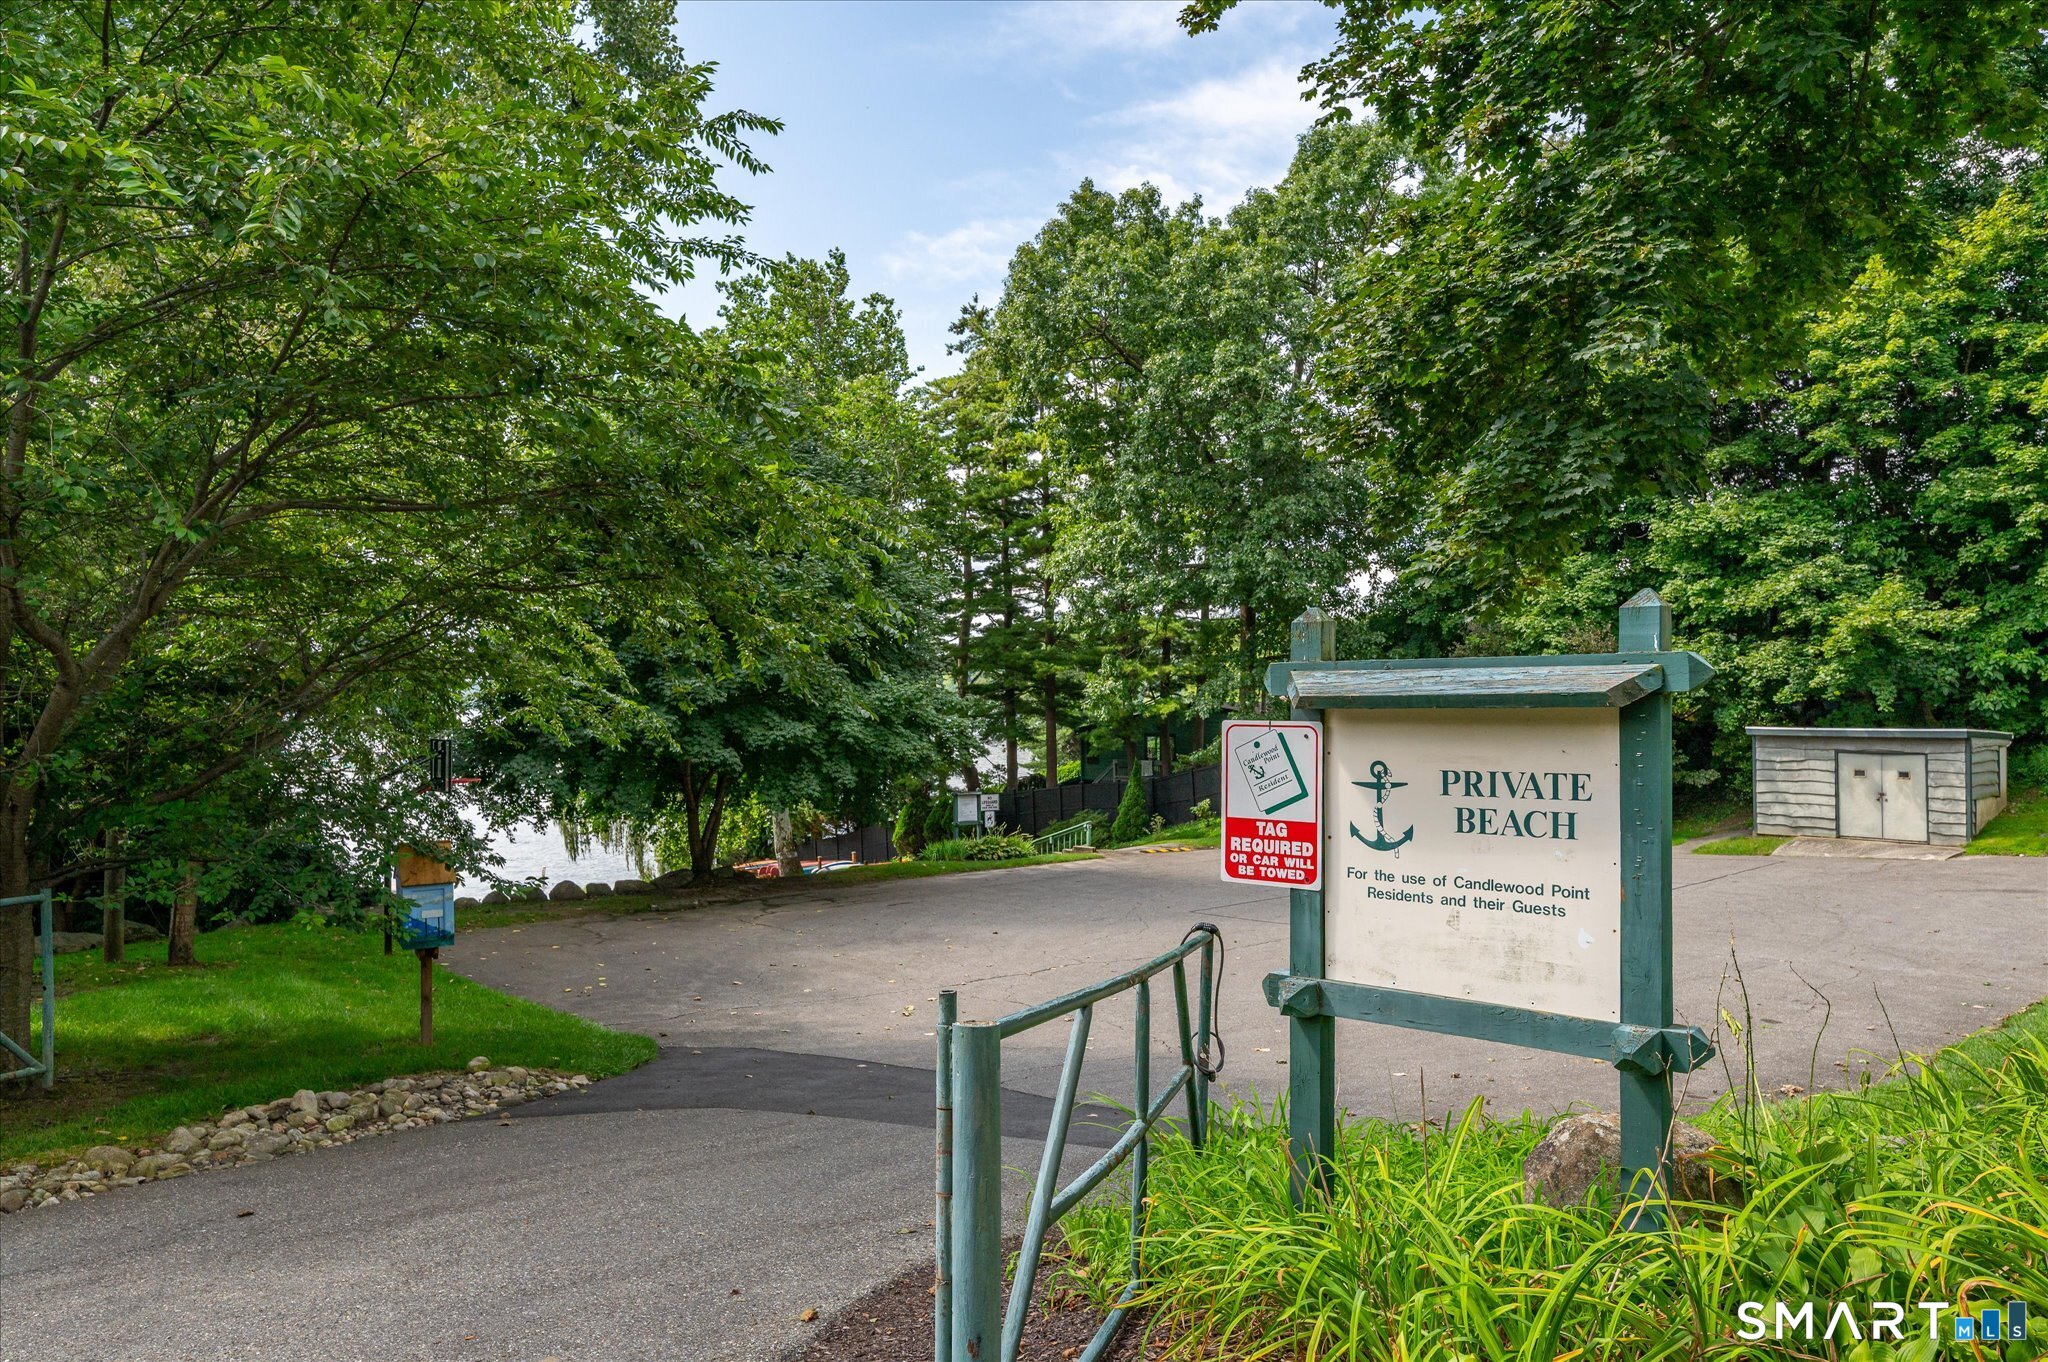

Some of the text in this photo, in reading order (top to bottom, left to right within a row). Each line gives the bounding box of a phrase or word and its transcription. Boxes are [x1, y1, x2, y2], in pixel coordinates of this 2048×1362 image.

[1243, 744, 1279, 767] Candlewood
[1263, 753, 1280, 764] Point
[1258, 774, 1289, 792] Resident
[1440, 769, 1593, 802] PRIVATE
[1256, 821, 1288, 837] TAG
[1455, 807, 1579, 840] BEACH
[1230, 836, 1314, 857] REQUIRED
[1230, 853, 1314, 869] OR CAR WILL
[1238, 865, 1305, 880] BE TOWED
[1347, 867, 1590, 900] For the use of Candlewood Point
[1367, 886, 1566, 917] Residents and their Guests
